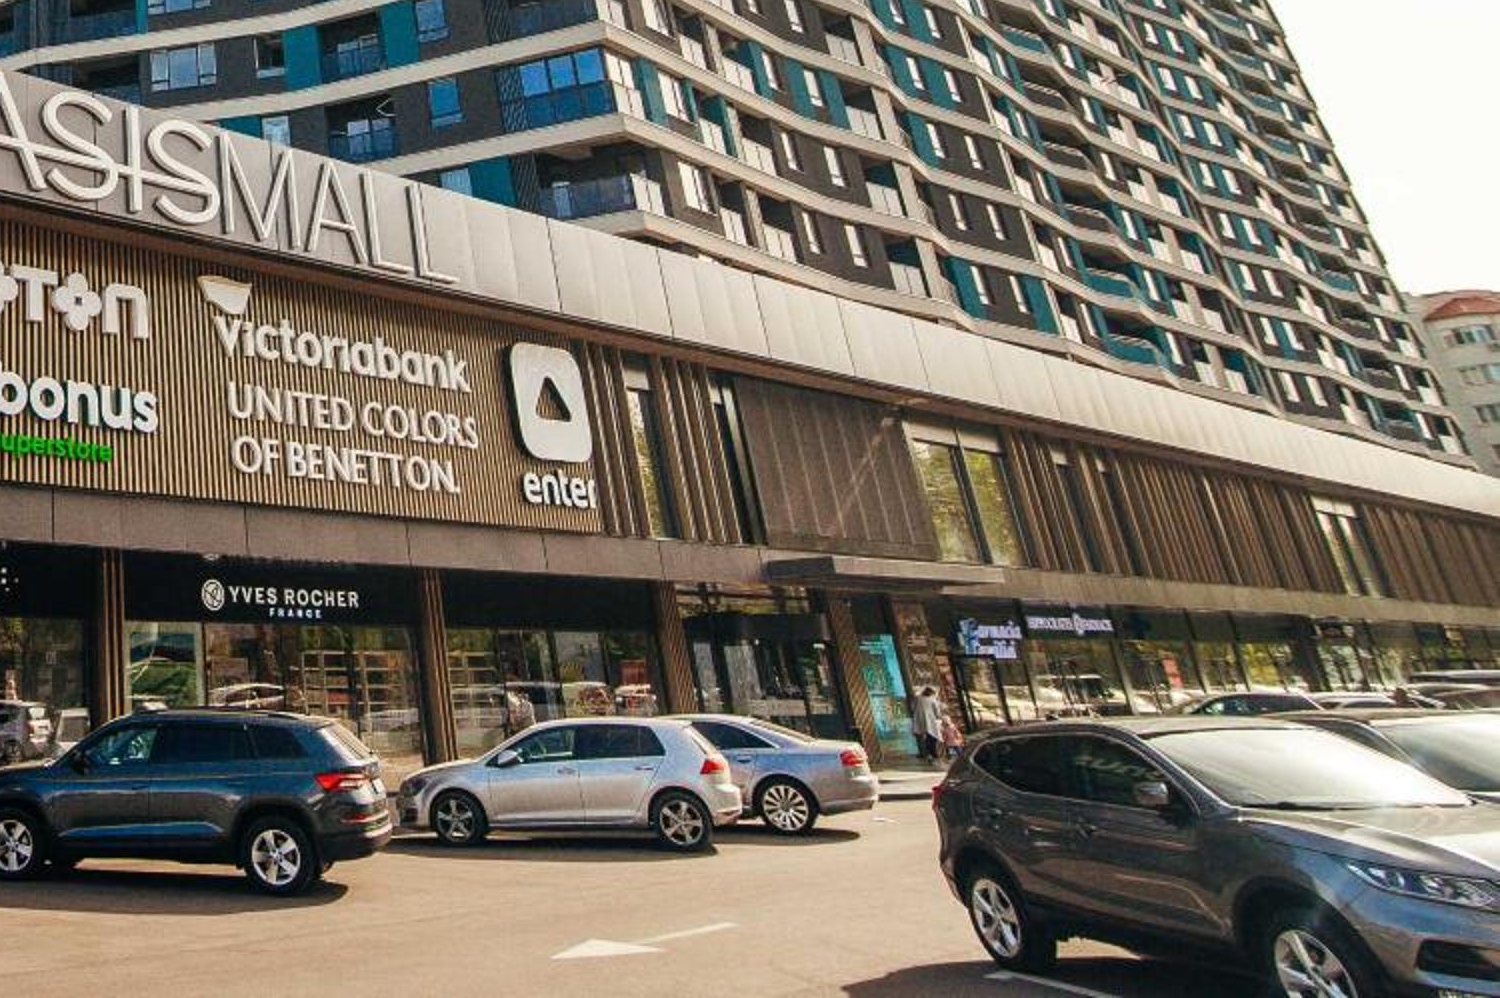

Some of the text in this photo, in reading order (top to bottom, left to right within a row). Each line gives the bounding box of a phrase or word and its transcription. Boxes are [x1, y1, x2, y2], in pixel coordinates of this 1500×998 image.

[227, 381, 480, 450] UNITED COLORS
[230, 435, 281, 476] OF
[523, 468, 597, 509] enter
[228, 585, 360, 609] YVES ROCHER
